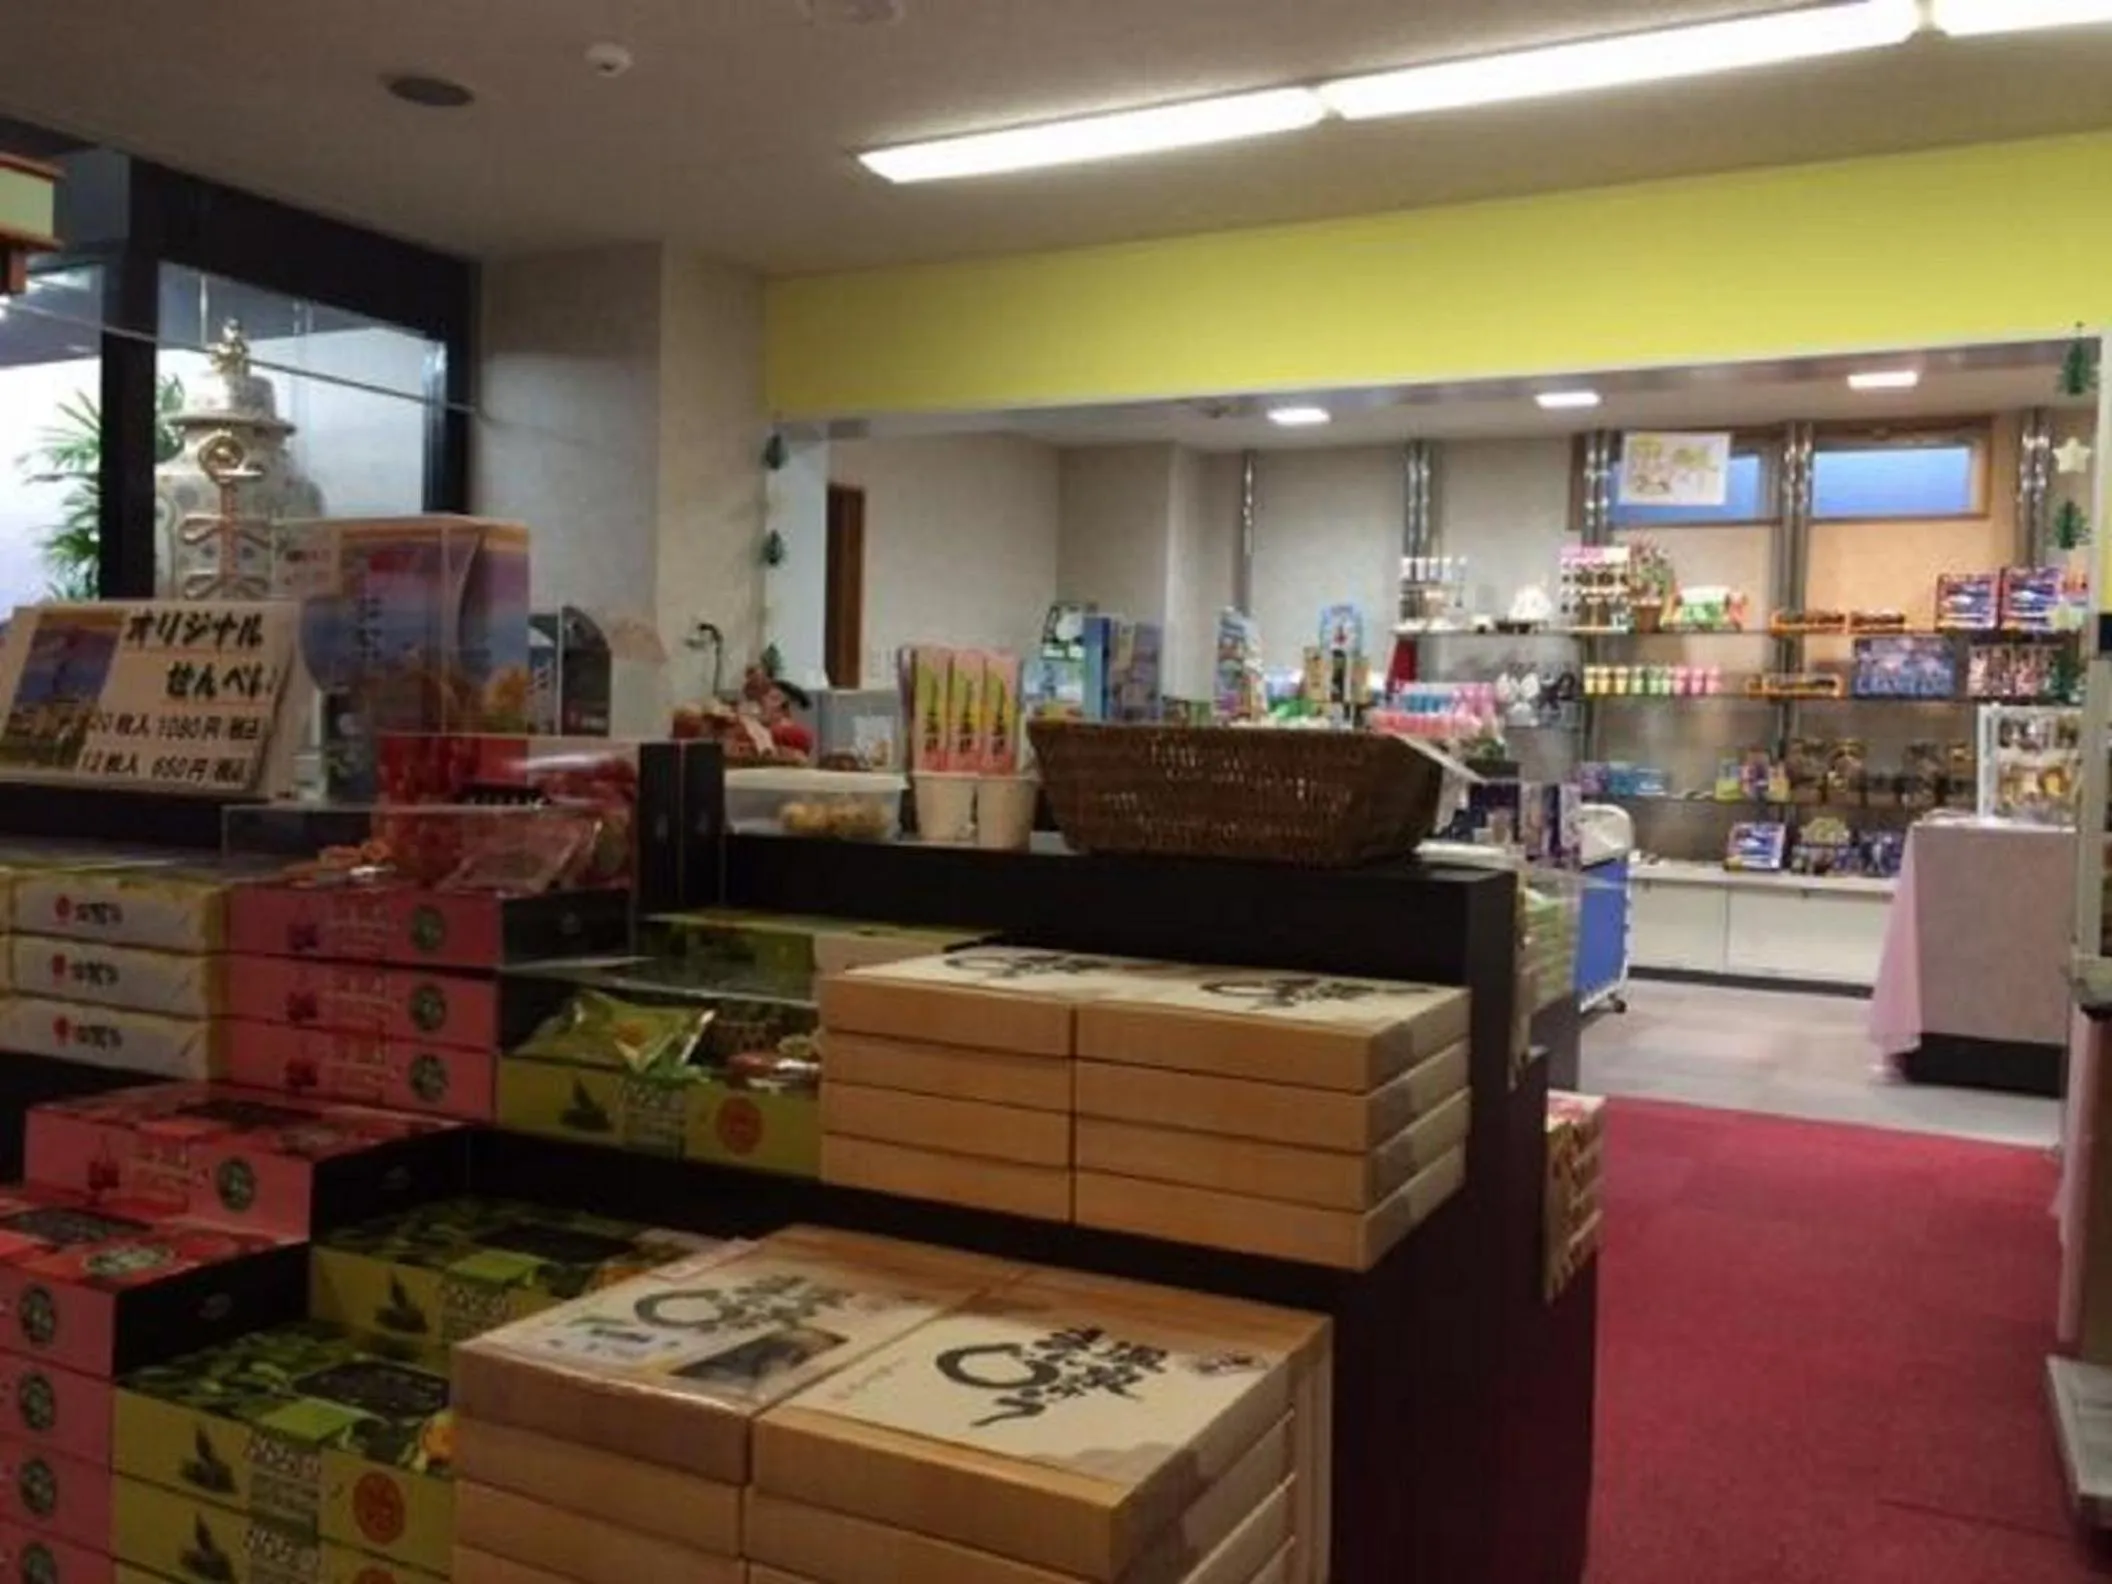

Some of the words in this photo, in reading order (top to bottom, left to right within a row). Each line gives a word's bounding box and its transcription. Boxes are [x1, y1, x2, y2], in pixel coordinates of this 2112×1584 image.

[126, 608, 264, 649] オリジナル
[166, 660, 279, 698] せんべい
